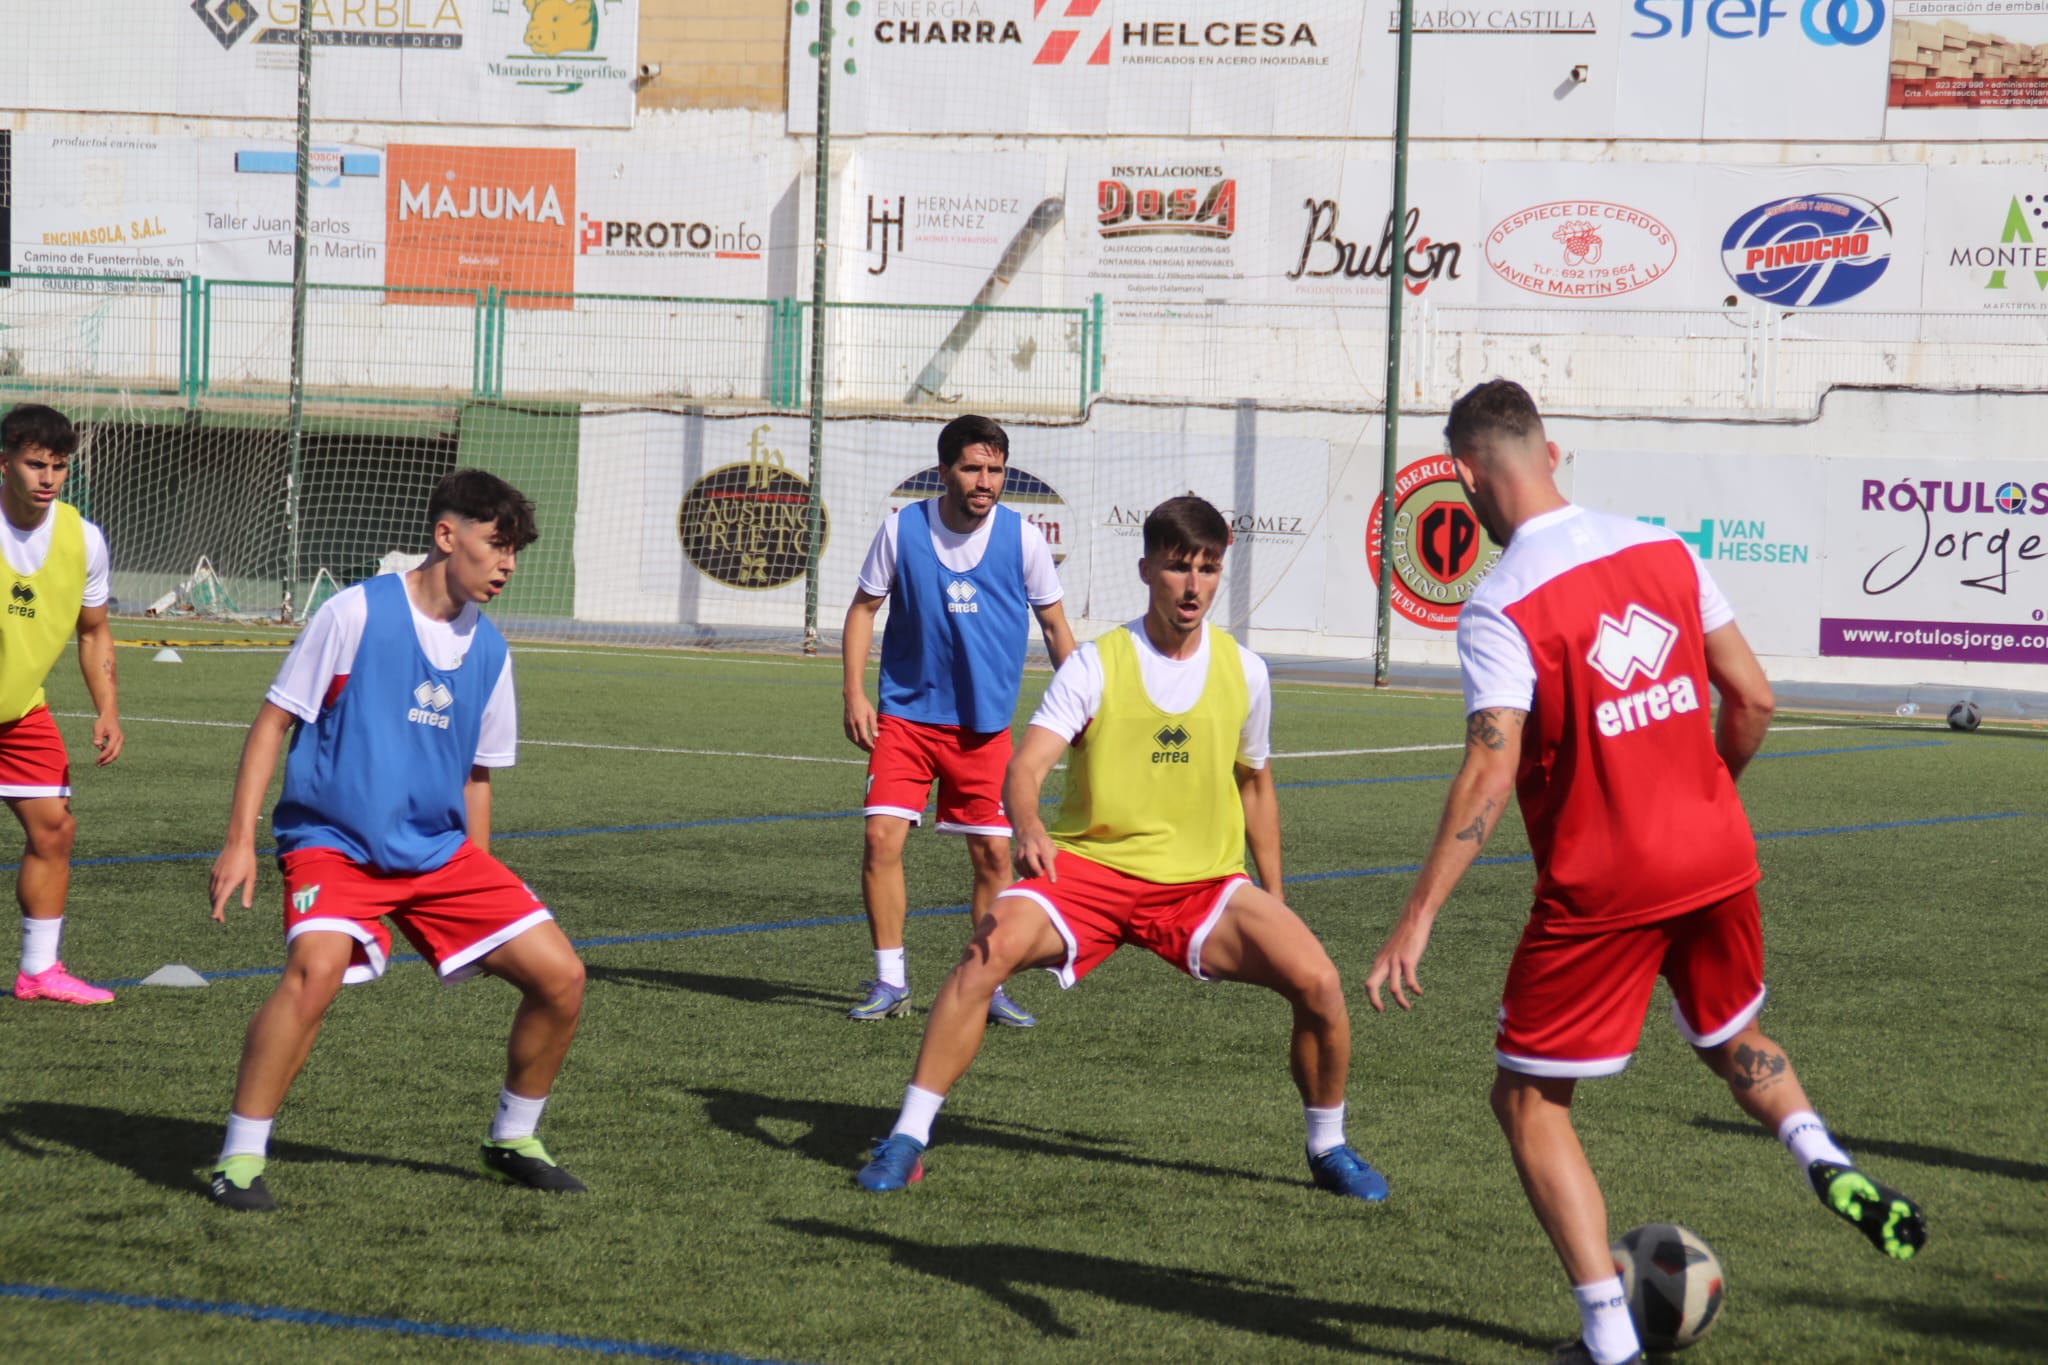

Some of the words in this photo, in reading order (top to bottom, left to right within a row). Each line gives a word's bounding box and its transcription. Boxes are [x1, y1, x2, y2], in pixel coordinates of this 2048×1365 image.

[1909, 2, 1983, 13] Elaboración
[1990, 0, 2001, 12] de
[1487, 10, 1596, 29] CASTILLA
[875, 20, 1022, 43] CHARRA
[1123, 22, 1318, 46] HELCESA
[1122, 55, 1195, 65] FABRICADOS
[1200, 56, 1214, 65] EN
[1217, 56, 1256, 65] ACERO
[1260, 56, 1329, 66] INOXIDABLE
[488, 63, 552, 77] Matadero
[556, 65, 627, 80] Frigorífico
[52, 136, 108, 148] productos
[1111, 166, 1223, 177] INSTALACIONES
[916, 194, 1020, 214] HERNÁNDEZ
[42, 224, 127, 246] ENCINASOLA,
[131, 215, 167, 240] S.A.L.
[205, 213, 248, 230] Taller
[252, 215, 291, 231] Juan
[310, 218, 350, 234] arlos
[915, 211, 985, 229] JIMÉNEZ
[1492, 204, 1573, 245] DESPIECE
[1577, 204, 1600, 217] DE
[1603, 206, 1670, 246] CERDOS
[605, 220, 762, 251] PROTOinfo
[24, 251, 67, 264] Camino
[70, 252, 84, 264] de
[87, 253, 163, 267] Fuenterroble,
[167, 257, 184, 268] s/n
[324, 241, 377, 260] Martín
[1745, 233, 1870, 271] PINUCHO
[1493, 260, 1545, 291] JAVIER
[1548, 279, 1612, 295] MARTÍN
[1615, 263, 1665, 291] S.L.U.
[1561, 268, 1585, 279] 692
[1589, 267, 1609, 278] 179
[1612, 263, 1636, 277] 664
[1719, 519, 1766, 539] VAN
[1862, 488, 2048, 595] Jorge
[1393, 511, 1449, 600] CEFERINO
[1718, 541, 1808, 564] HESSEN
[1843, 629, 2048, 650] www.rotulosjorge.co
[1595, 675, 1700, 737] errea
[407, 707, 450, 730] errea
[1151, 751, 1190, 764] errea
